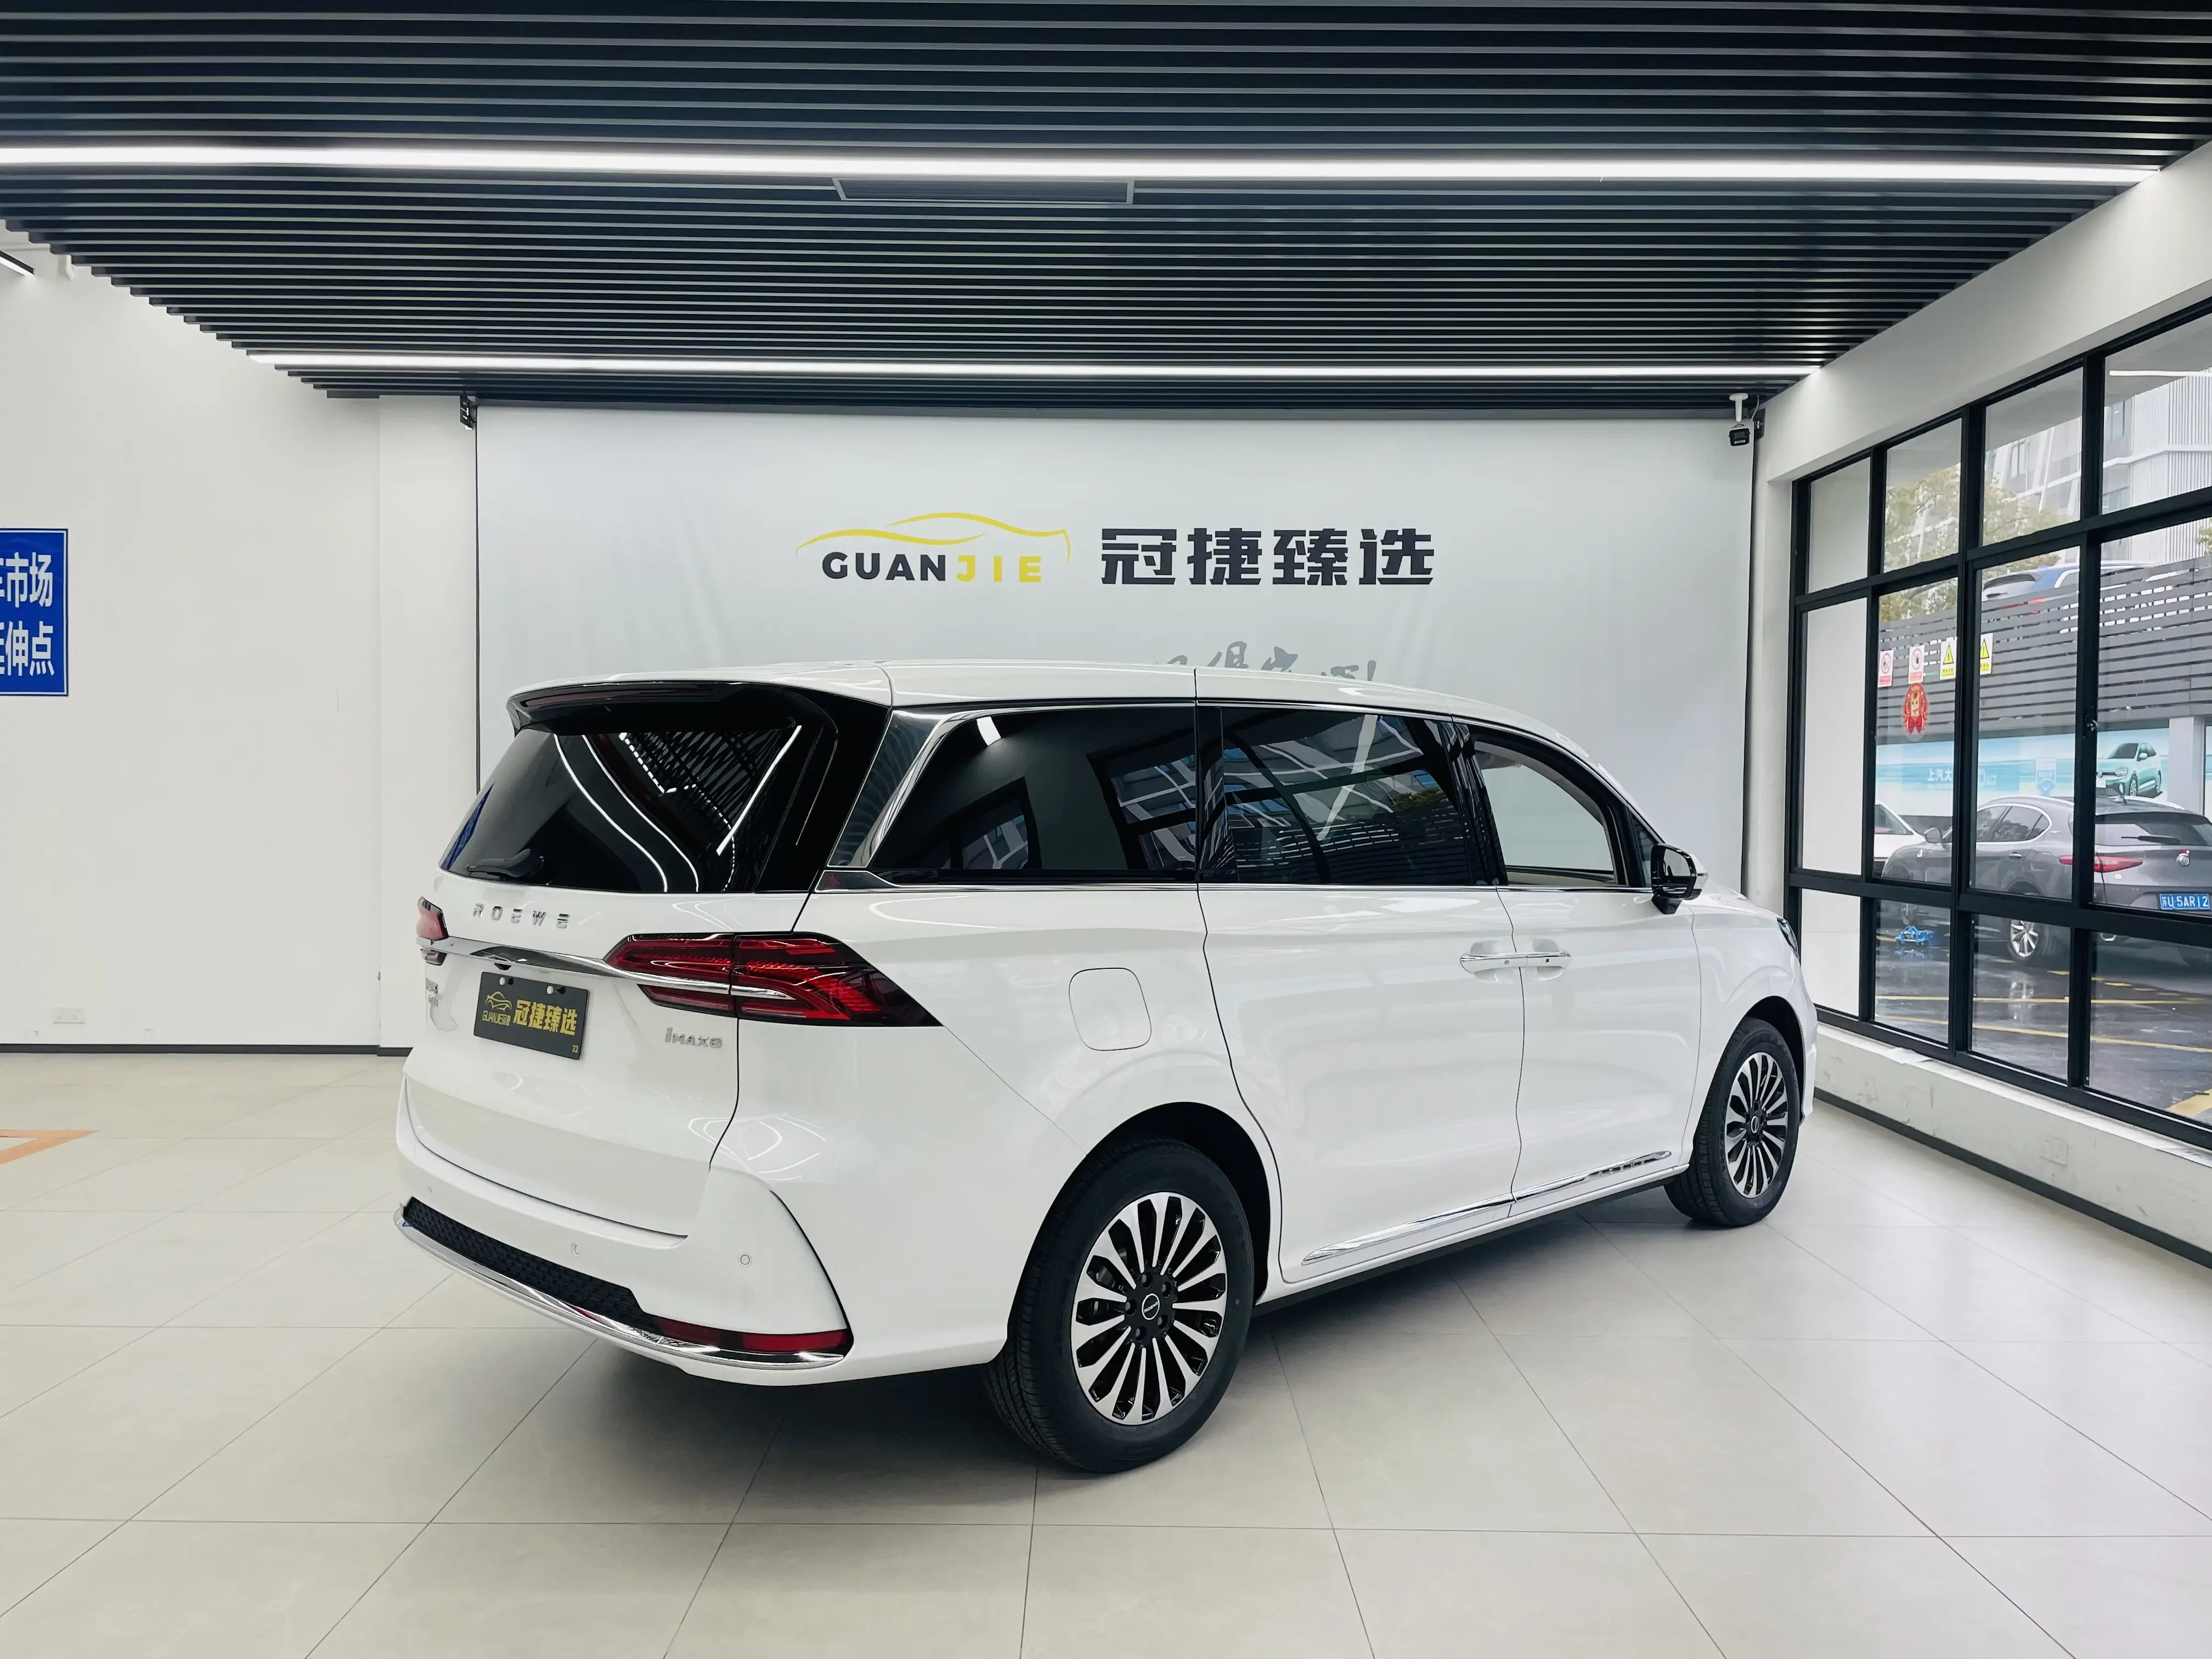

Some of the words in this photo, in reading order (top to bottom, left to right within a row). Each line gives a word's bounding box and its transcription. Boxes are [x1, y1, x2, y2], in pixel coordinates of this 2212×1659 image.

[0, 551, 53, 608] 市场
[822, 551, 1041, 583] GUANJIE
[1101, 528, 1435, 586] 冠捷臻选
[0, 620, 55, 676] 伸点
[472, 903, 571, 929] ROEWE
[513, 999, 578, 1036] 冠捷臻选
